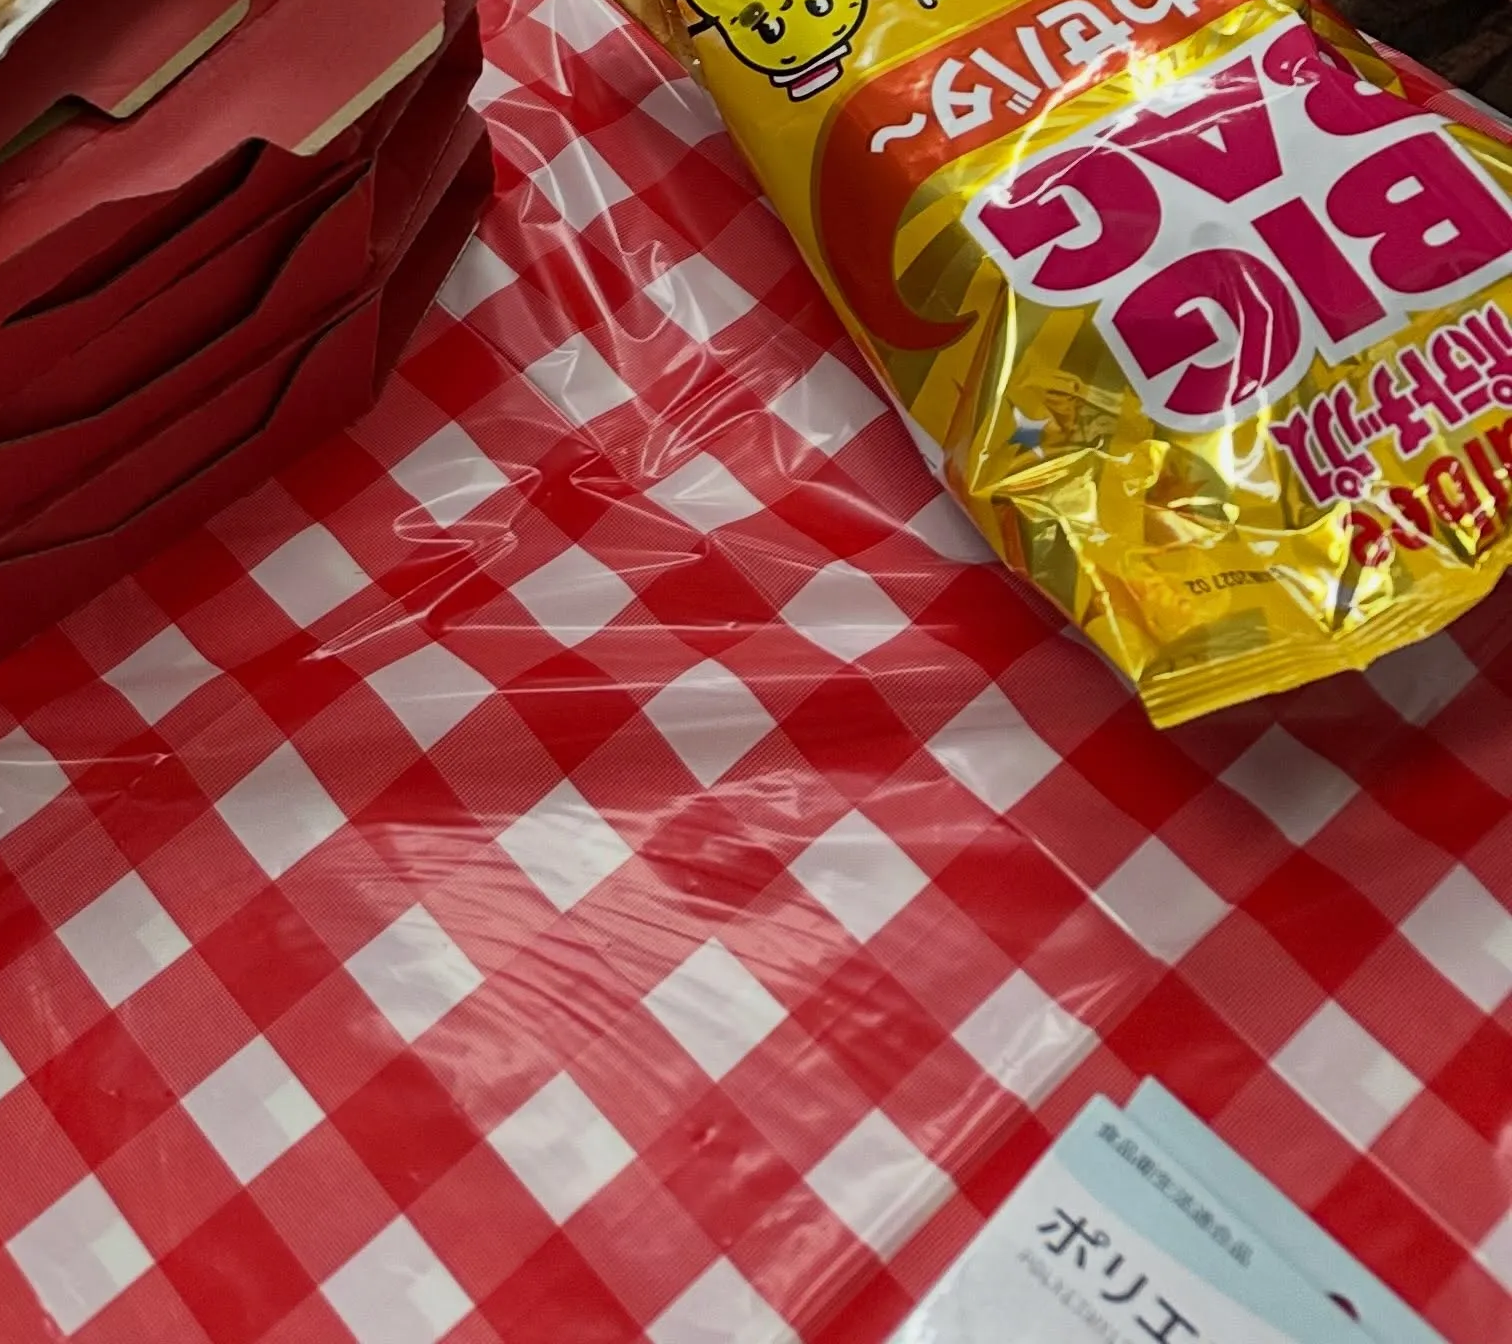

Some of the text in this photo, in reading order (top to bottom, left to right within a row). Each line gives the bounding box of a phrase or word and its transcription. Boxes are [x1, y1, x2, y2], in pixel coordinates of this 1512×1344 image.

[978, 23, 1422, 291] BAG
[1112, 130, 1512, 416] BIG
[1271, 304, 1512, 503] ポテトチップス
